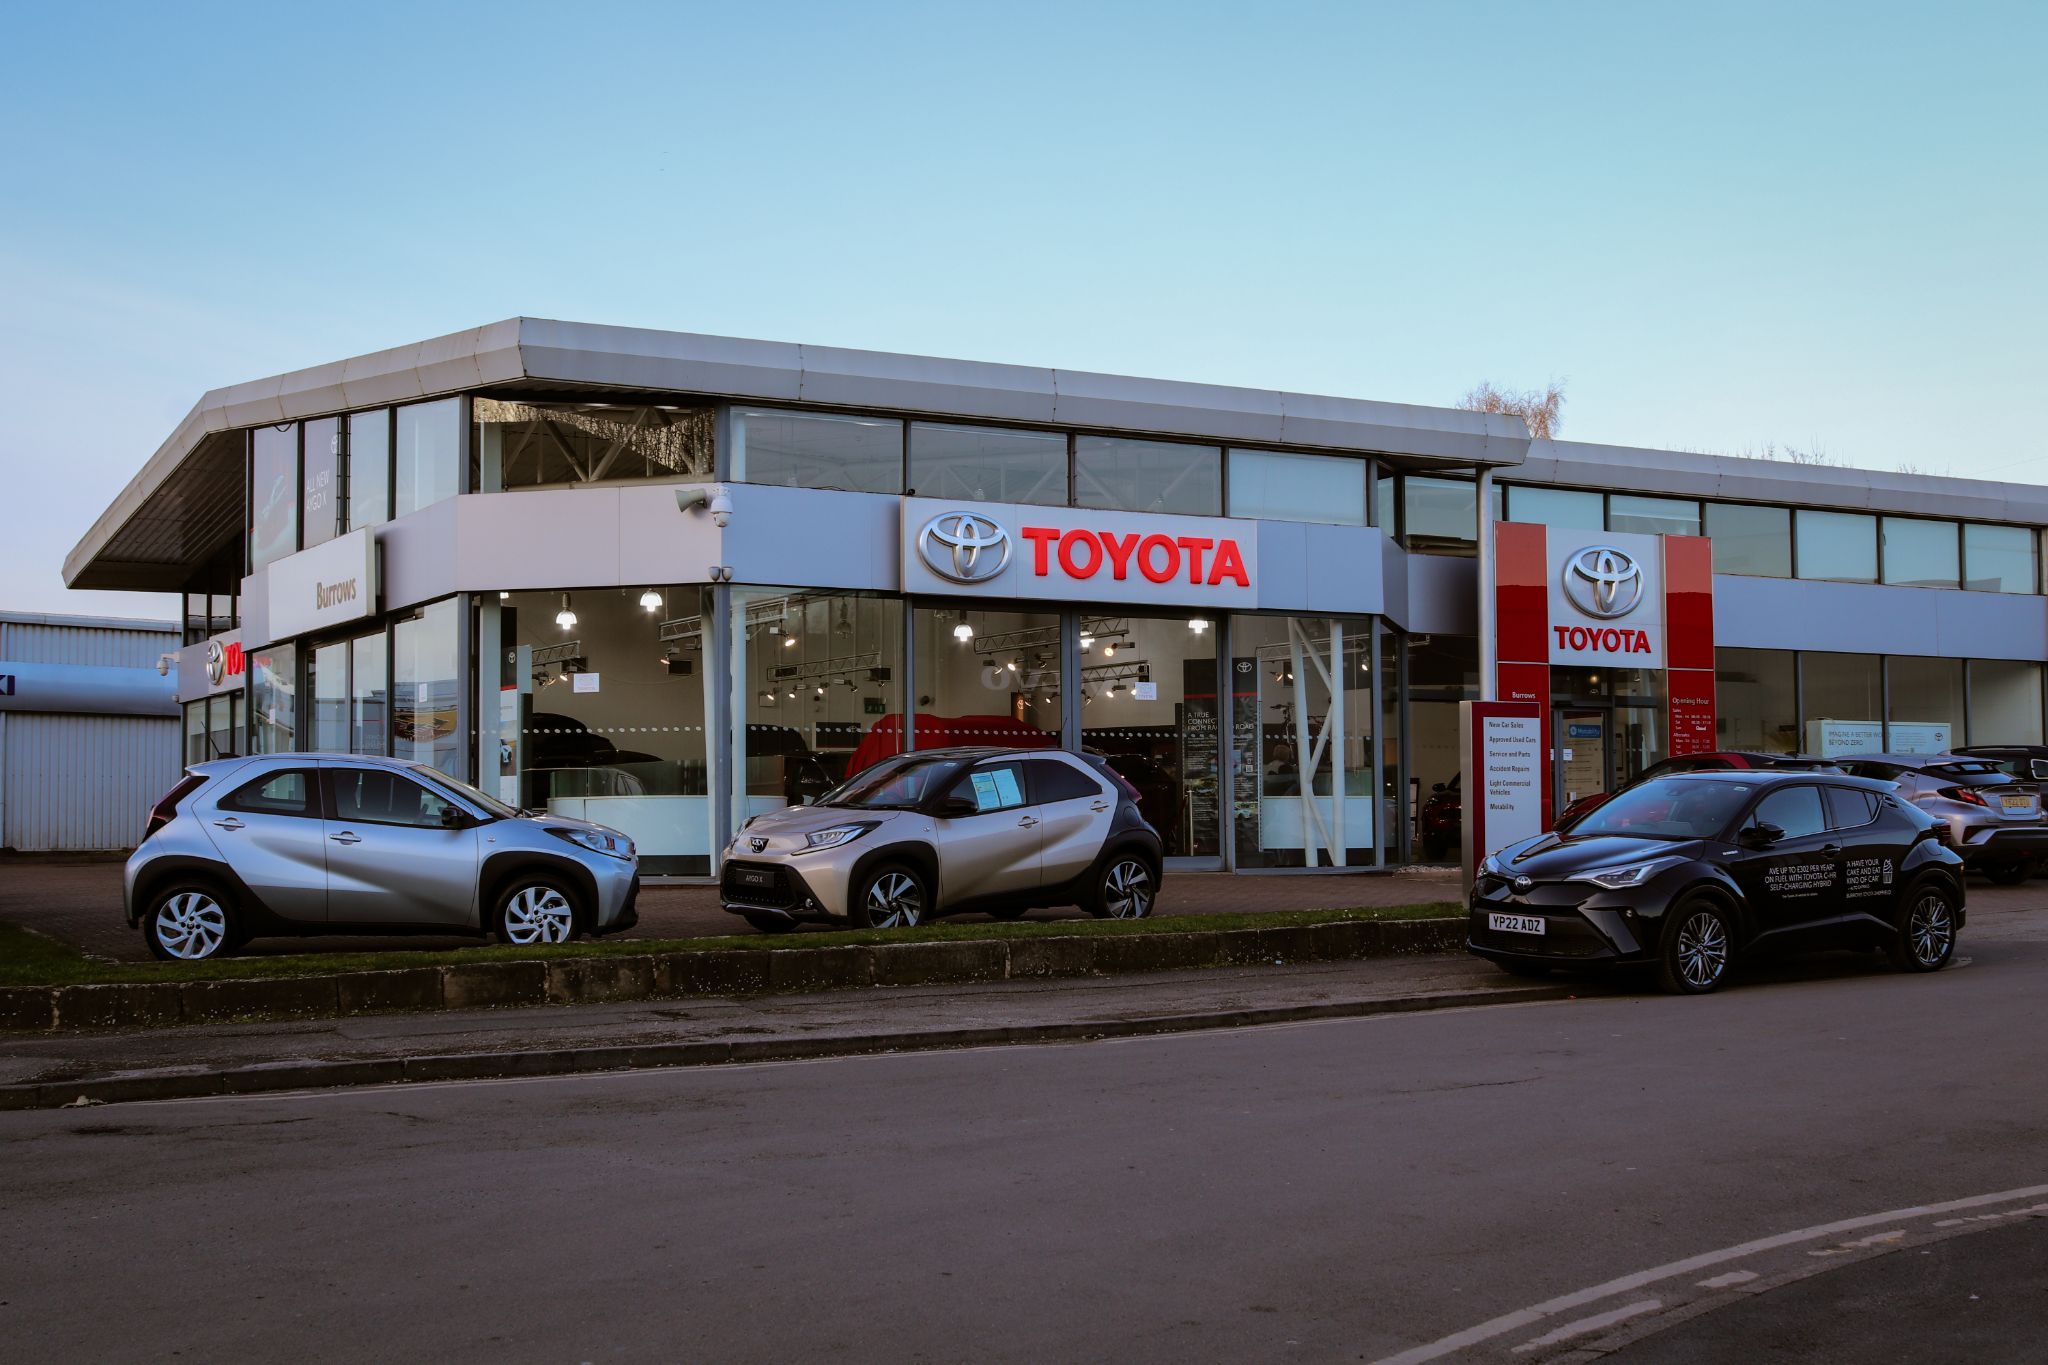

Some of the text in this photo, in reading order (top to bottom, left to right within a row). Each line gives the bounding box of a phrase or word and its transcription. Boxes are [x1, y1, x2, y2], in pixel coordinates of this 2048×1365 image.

[316, 469, 330, 488] NEW
[1022, 527, 1250, 587] TOYOTA
[317, 578, 357, 611] Burrows
[1553, 625, 1652, 654] TOYOTA
[1511, 691, 1536, 699] Burrows
[1672, 697, 1695, 705] Opening
[1489, 736, 1512, 744] Approved
[1490, 803, 1514, 811] Motability
[1865, 858, 1879, 866] YOUR
[1810, 864, 1820, 872] PER
[1846, 866, 1881, 876] CAKE AND EAT
[1803, 872, 1823, 880] TOYOTA
[1846, 876, 1859, 884] KIND
[1860, 875, 1867, 883] OF
[1770, 879, 1832, 891] SELF-CHARGING HYBRID
[1493, 915, 1541, 932] YP22 ADZ
